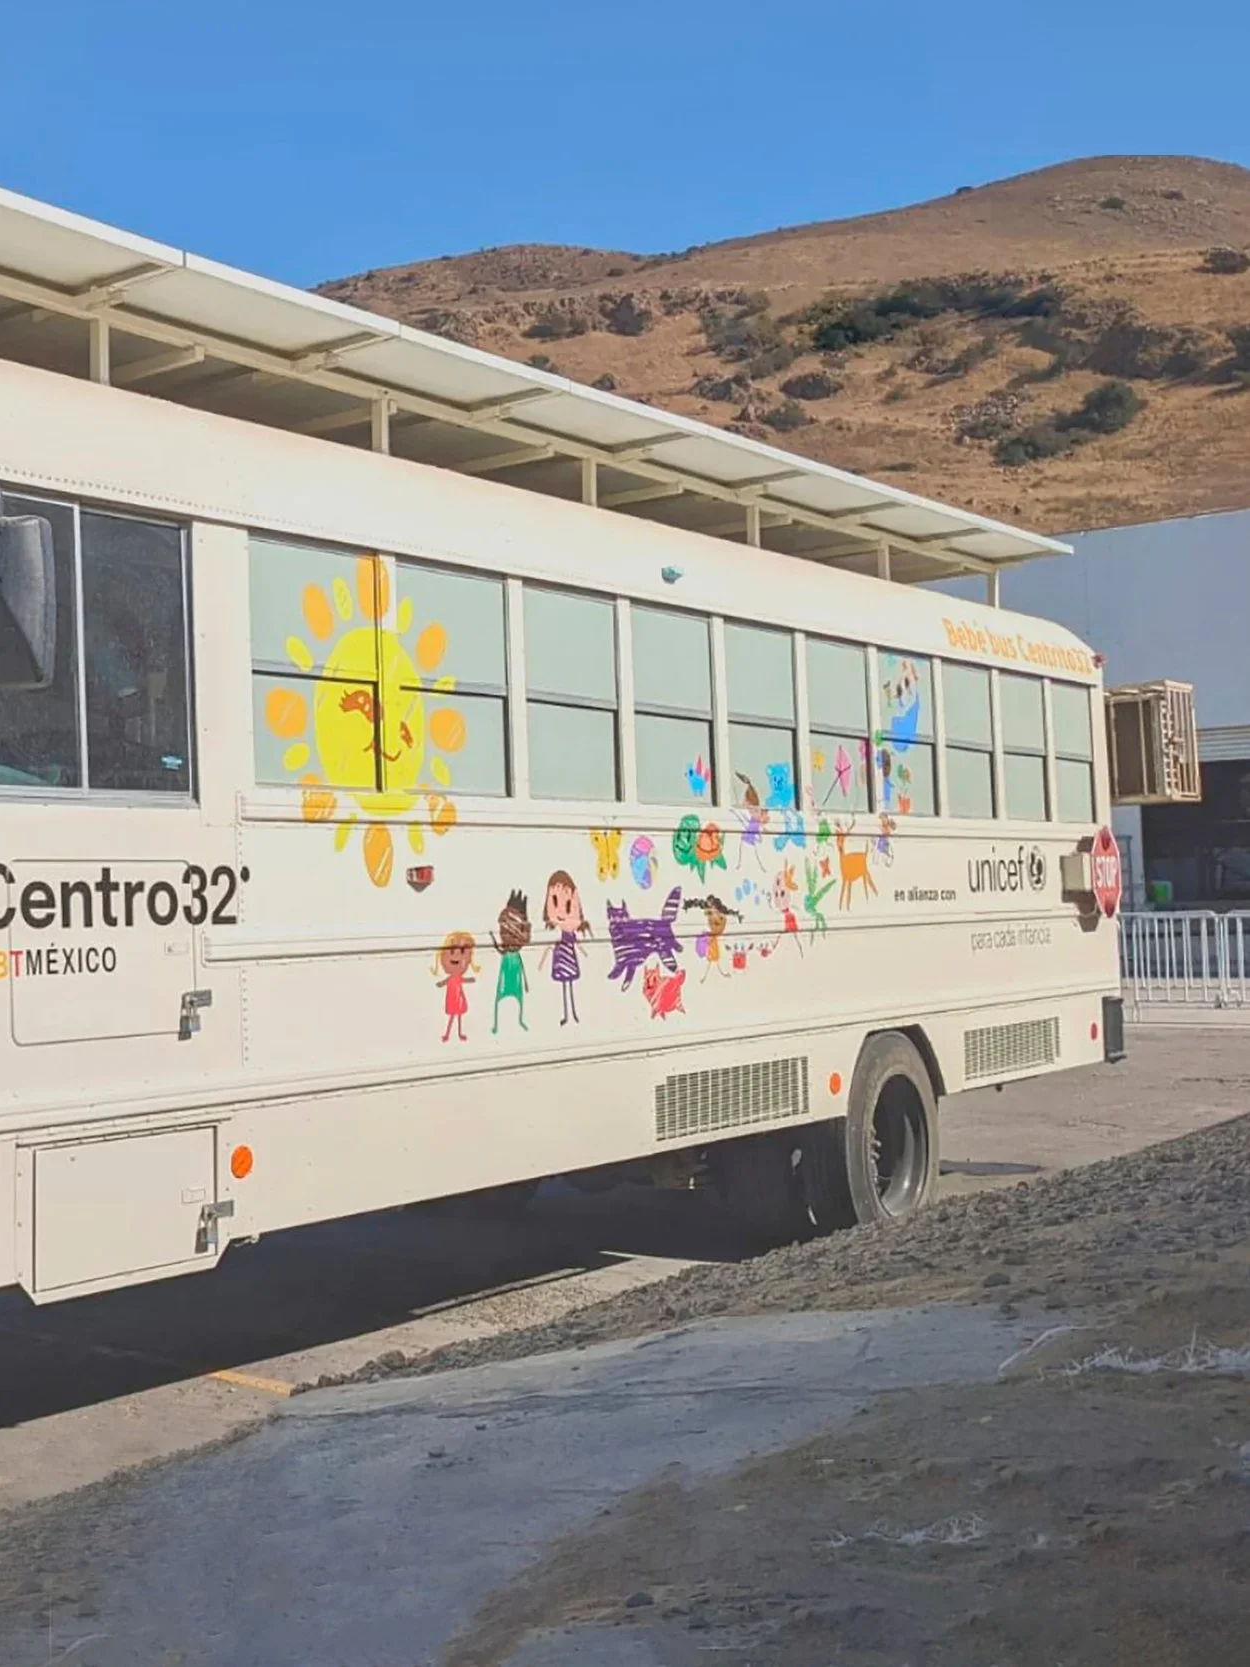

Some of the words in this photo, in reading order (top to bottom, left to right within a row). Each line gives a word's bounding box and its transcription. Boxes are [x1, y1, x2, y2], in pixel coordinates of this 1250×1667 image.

[967, 845, 1025, 893] unicef
[1095, 855, 1119, 888] STOP
[894, 889, 905, 902] en
[907, 887, 939, 902] alianza
[940, 889, 956, 901] con
[970, 931, 993, 953] para
[993, 924, 1016, 949] cada
